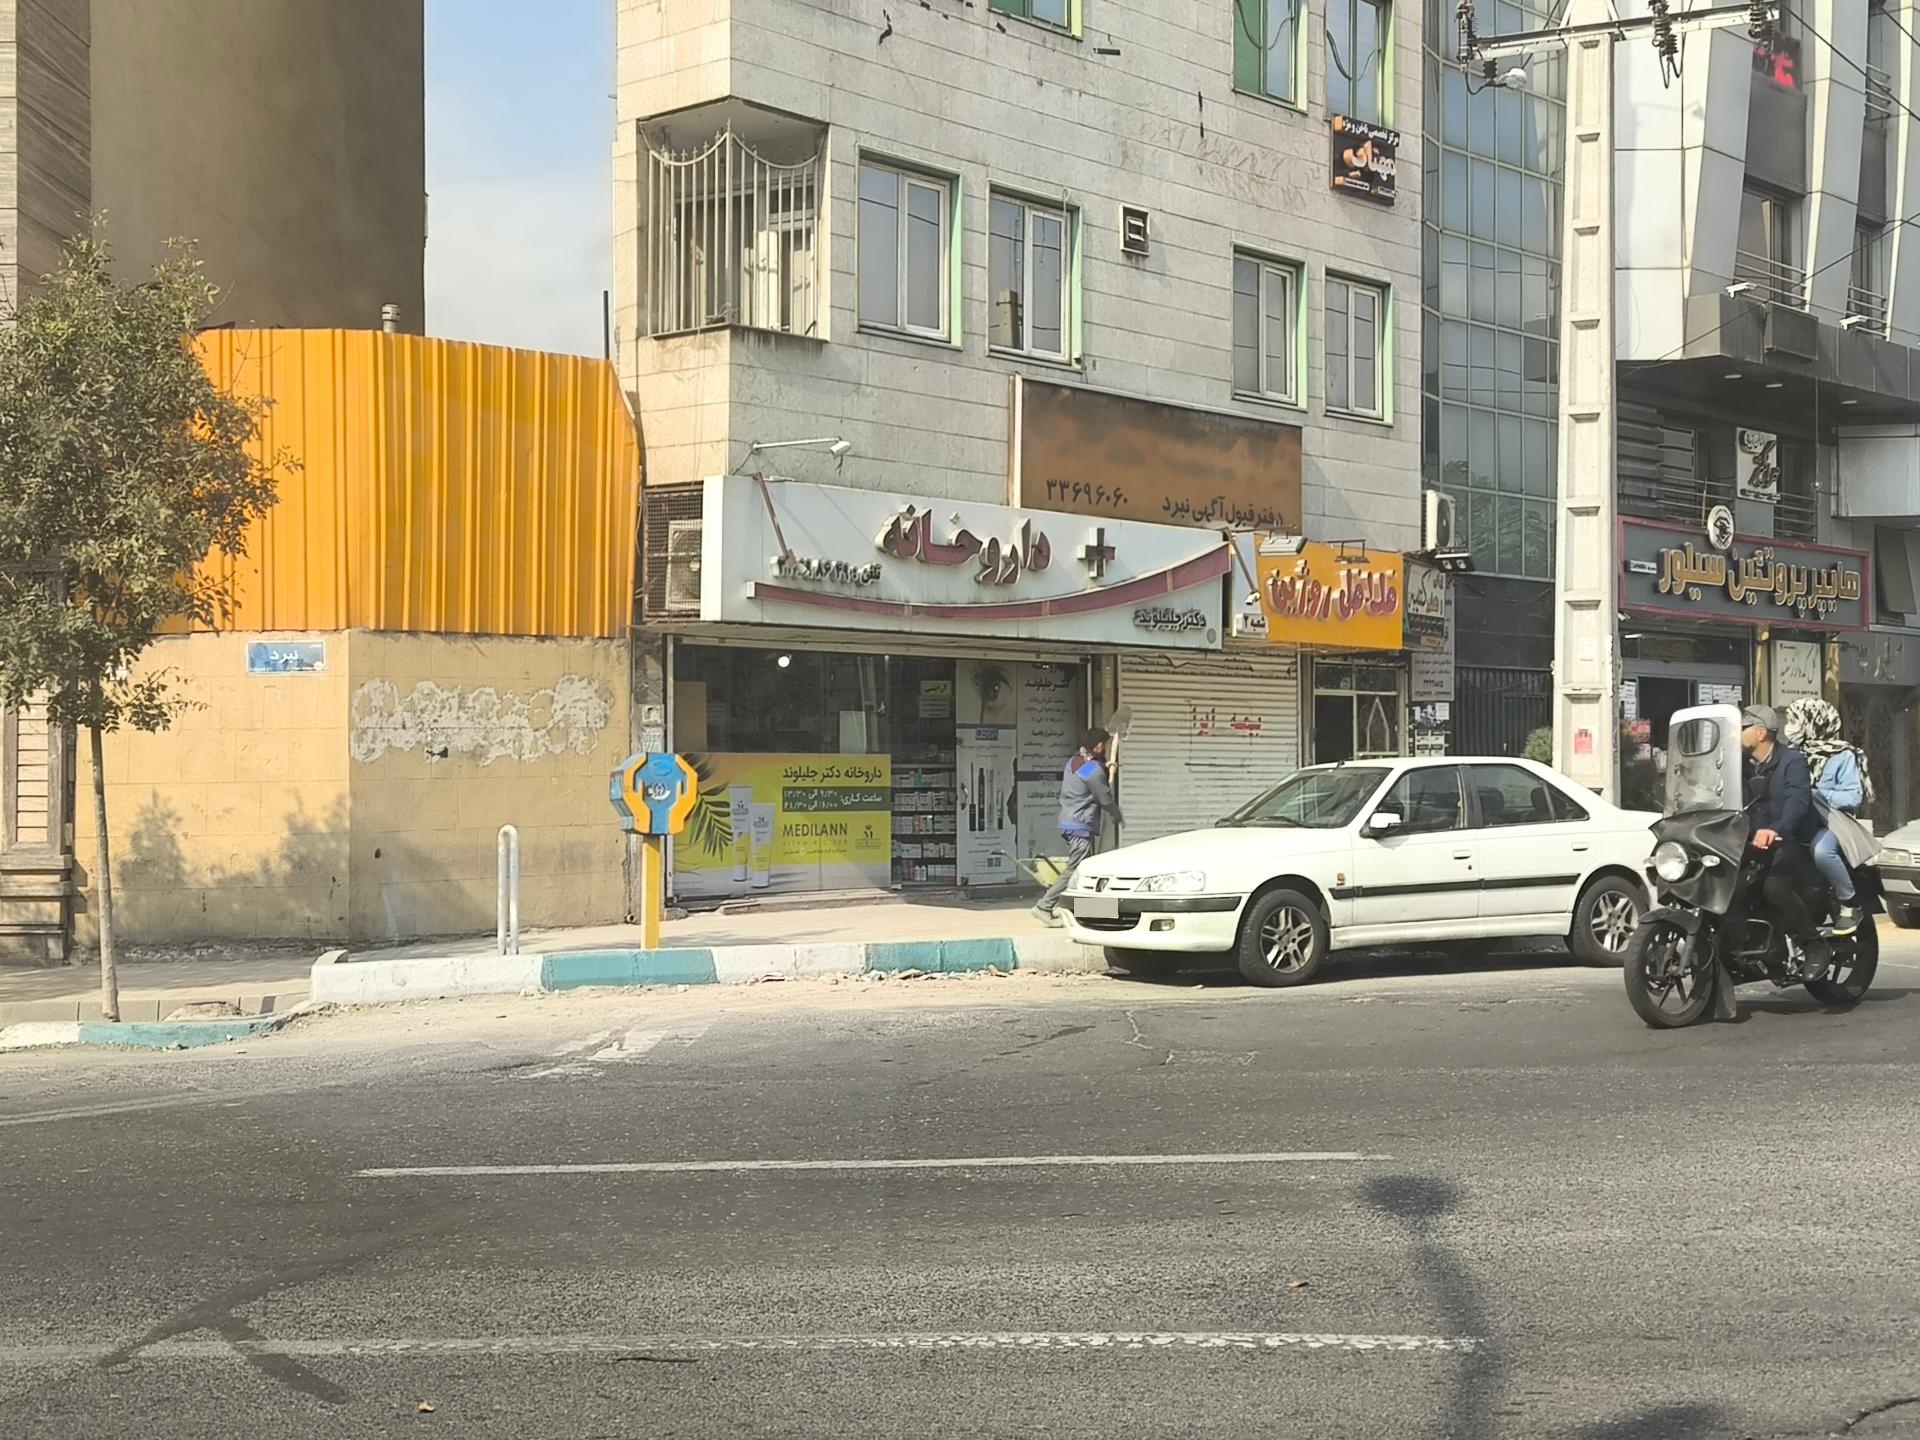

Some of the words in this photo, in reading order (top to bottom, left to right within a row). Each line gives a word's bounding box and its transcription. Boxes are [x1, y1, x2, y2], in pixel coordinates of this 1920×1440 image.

[1046, 479, 1129, 508] ۳۳۶۹۶۰۶۰
[1162, 496, 1190, 518] نبرد
[1192, 495, 1227, 522] آگهی
[1226, 503, 1256, 527] قبول
[876, 503, 1052, 585] داروخانه
[1657, 542, 1727, 602] سیلور
[1728, 546, 1808, 619] پروتئین
[1267, 559, 1332, 619] روژین
[1338, 567, 1398, 619] فلافل
[1808, 561, 1861, 620] هایپر
[1181, 607, 1207, 629] دکتر
[1250, 615, 1266, 631] شعبه
[782, 766, 818, 783] جلیلوند
[820, 765, 841, 783] دکتر
[844, 766, 882, 783] داروخانه
[861, 792, 882, 803] ساعت
[782, 822, 848, 837] MEDILANN
